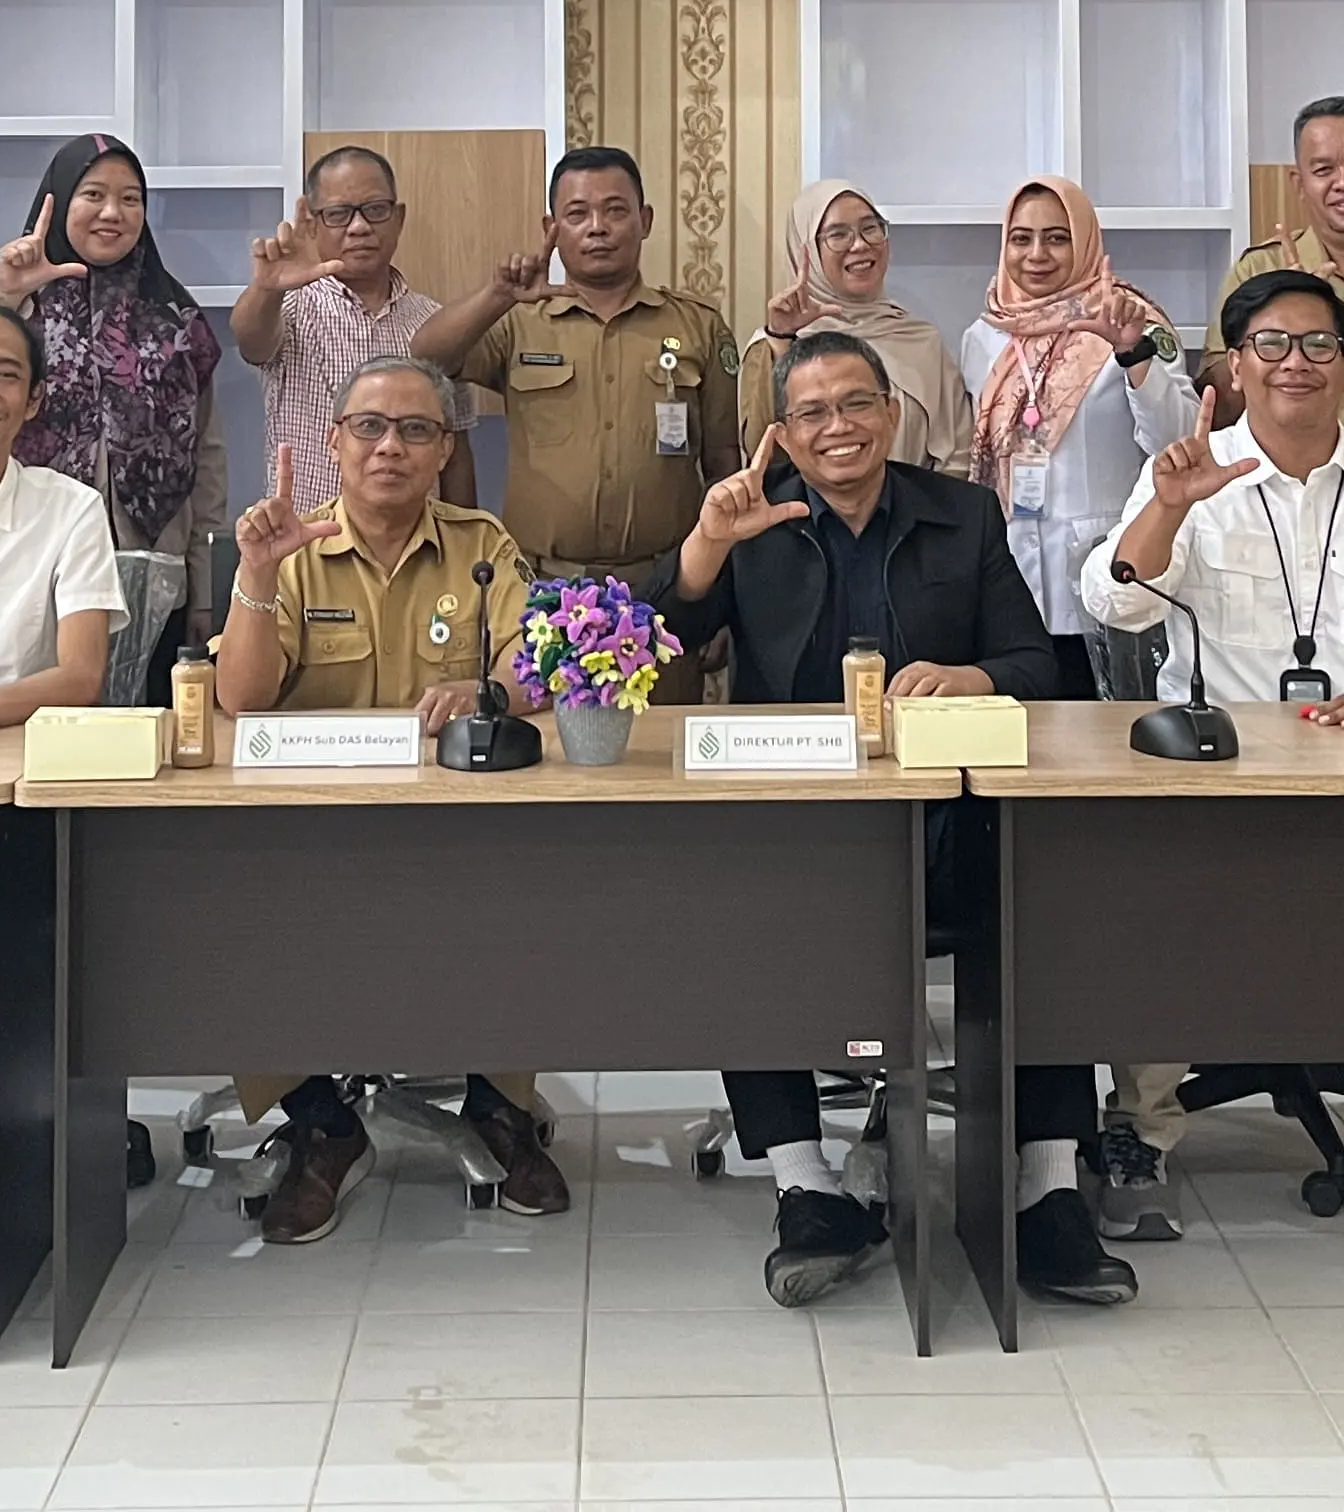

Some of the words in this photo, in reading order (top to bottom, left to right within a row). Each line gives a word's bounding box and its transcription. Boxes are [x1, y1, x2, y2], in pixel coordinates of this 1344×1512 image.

[338, 735, 362, 745] DAS
[364, 735, 409, 746] Belayan
[733, 737, 794, 747] DIREKTUR
[796, 737, 812, 746] PT
